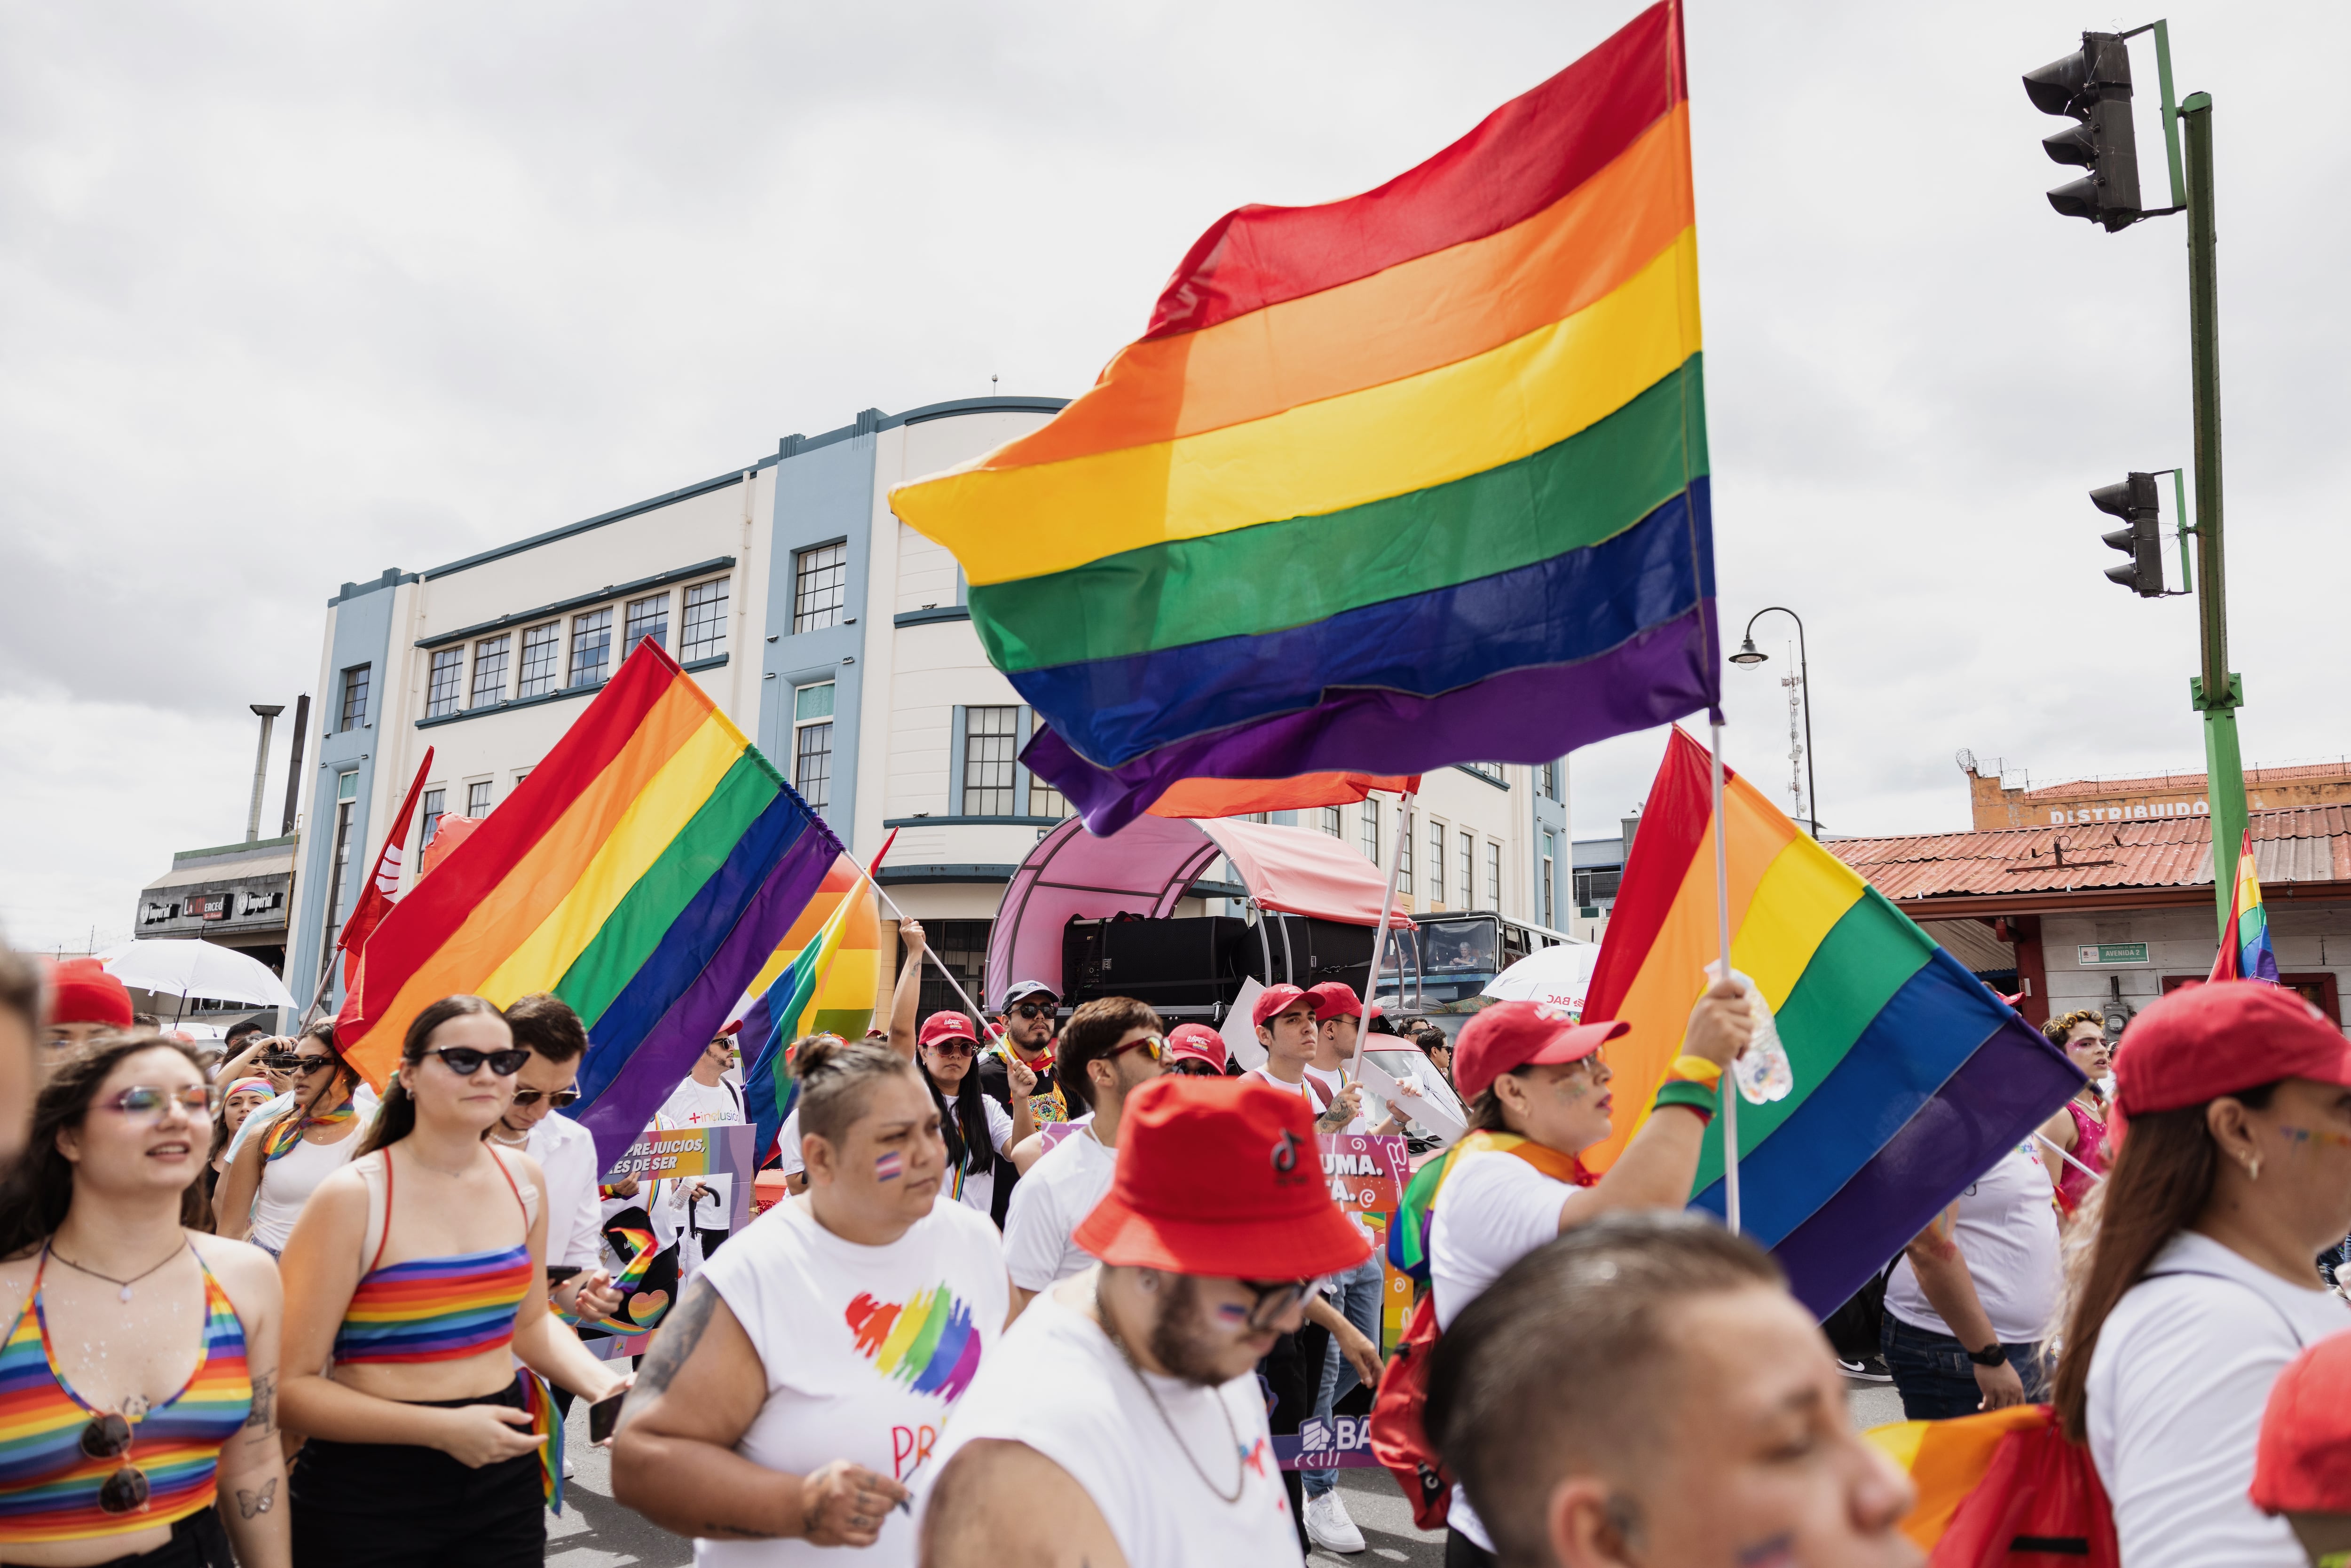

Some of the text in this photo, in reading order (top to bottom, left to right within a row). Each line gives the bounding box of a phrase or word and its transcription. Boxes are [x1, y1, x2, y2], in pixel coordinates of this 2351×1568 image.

[248, 892, 273, 912] Imperial
[149, 904, 171, 922] Imperial
[624, 1139, 706, 1157] PREJUICIOS,
[609, 1156, 678, 1174] ES DE SER
[892, 1420, 941, 1479] PR
